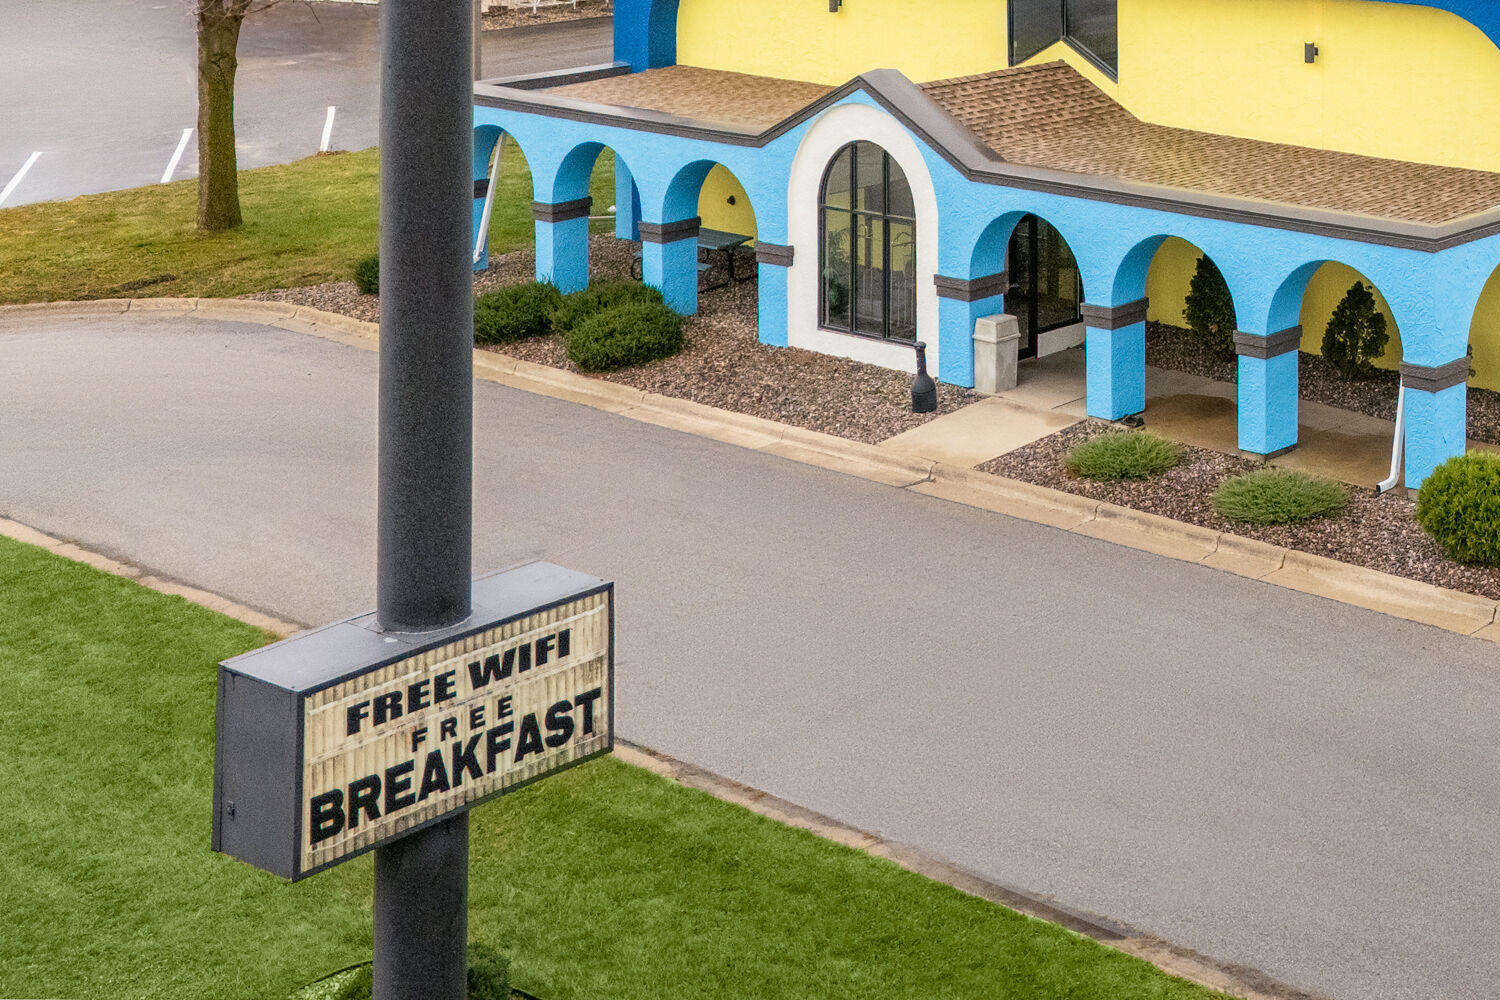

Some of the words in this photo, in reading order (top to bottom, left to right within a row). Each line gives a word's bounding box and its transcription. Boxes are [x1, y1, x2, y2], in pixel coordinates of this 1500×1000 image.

[347, 670, 456, 736] FREE
[468, 628, 570, 690] WIFI
[412, 695, 513, 752] FREE
[310, 687, 601, 845] BREAKFAST
